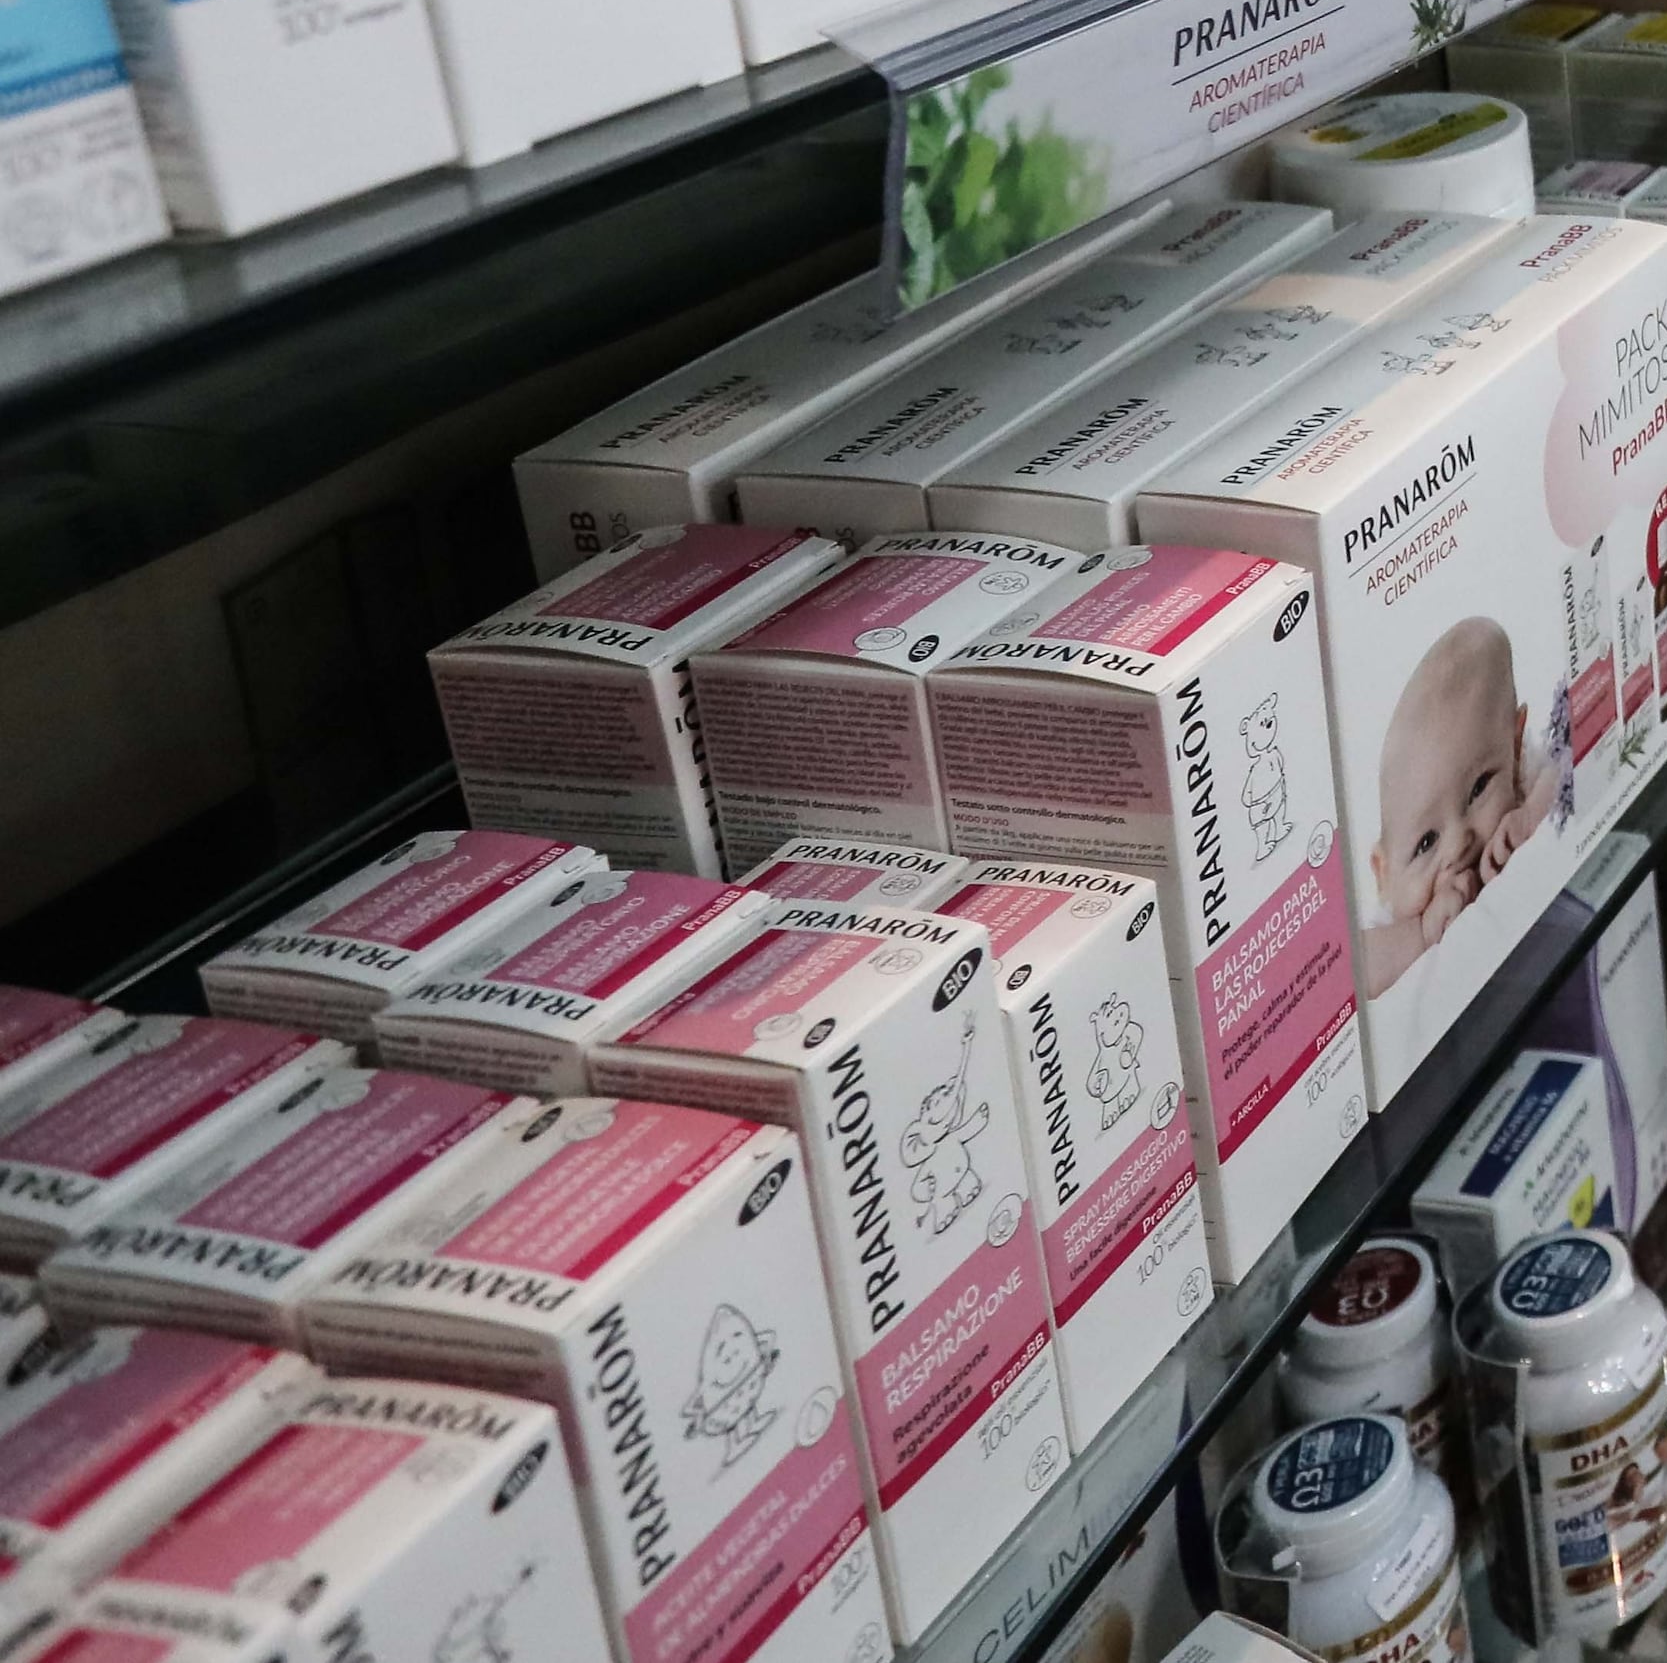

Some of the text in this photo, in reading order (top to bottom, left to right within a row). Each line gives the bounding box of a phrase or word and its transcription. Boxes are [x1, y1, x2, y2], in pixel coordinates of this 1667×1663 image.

[1189, 32, 1326, 113] AROMATERAPIA
[1207, 71, 1304, 133] CIENTÍFICA
[1519, 223, 1593, 270] PranaBB
[823, 386, 959, 464] PRANARŌM
[1015, 397, 1150, 475] PRANARŌM
[1222, 405, 1344, 486] PRANARŌM
[1277, 417, 1365, 481] AROMATERAPIA
[1308, 428, 1375, 476] CIENTÍFICA
[1343, 435, 1478, 564] PRANARŌM
[876, 537, 1066, 573] PRANARŌM
[1229, 561, 1270, 596] PranaBB
[1366, 499, 1470, 596] AROMATERAPIA
[1383, 535, 1459, 607] CIENTÍFICA
[1280, 595, 1309, 637] BIO
[1563, 565, 1579, 679] PRANARŌM
[951, 643, 1156, 679] PRANARŌM
[1176, 675, 1231, 948] PRANARŌM
[503, 845, 564, 887] PranaBB
[787, 845, 949, 875] PRANARŌM
[977, 863, 1136, 897] PRANARŌM
[684, 889, 741, 933] PranaBB
[777, 909, 961, 945] PRANARŌM
[1212, 874, 1319, 992] BÁLSAMO PARA
[941, 958, 972, 1000] BIO
[1215, 893, 1328, 1015] LAS ROJECES DEL
[1262, 991, 1288, 1024] calma
[1295, 940, 1332, 987] estimula
[407, 982, 596, 1022] PRANARŌM
[1218, 987, 1267, 1038] PAÑAL
[1234, 1036, 1260, 1072] poder
[1260, 987, 1307, 1041] reparador
[1316, 1001, 1354, 1053] PranaBB
[1030, 991, 1077, 1206] PRANARŌM
[1235, 1082, 1270, 1125] ARCILLA
[826, 1042, 906, 1333] PRANARŌM
[1064, 1130, 1169, 1246] SPRAY MASSAGGIO
[1066, 1129, 1188, 1265] BENESSERE DIGESTIVO
[1142, 1171, 1194, 1235] PranaBB
[335, 1259, 577, 1314] PRANARŌM
[881, 1282, 982, 1392] BALSAMO
[886, 1266, 1024, 1415] RESPIRAZIONE
[990, 1331, 1045, 1400] PranaBB
[892, 1342, 991, 1446] Respirazione
[896, 1383, 974, 1466] agevolata
[588, 1303, 677, 1589] PRANARŌM
[1570, 1435, 1630, 1473] DHA
